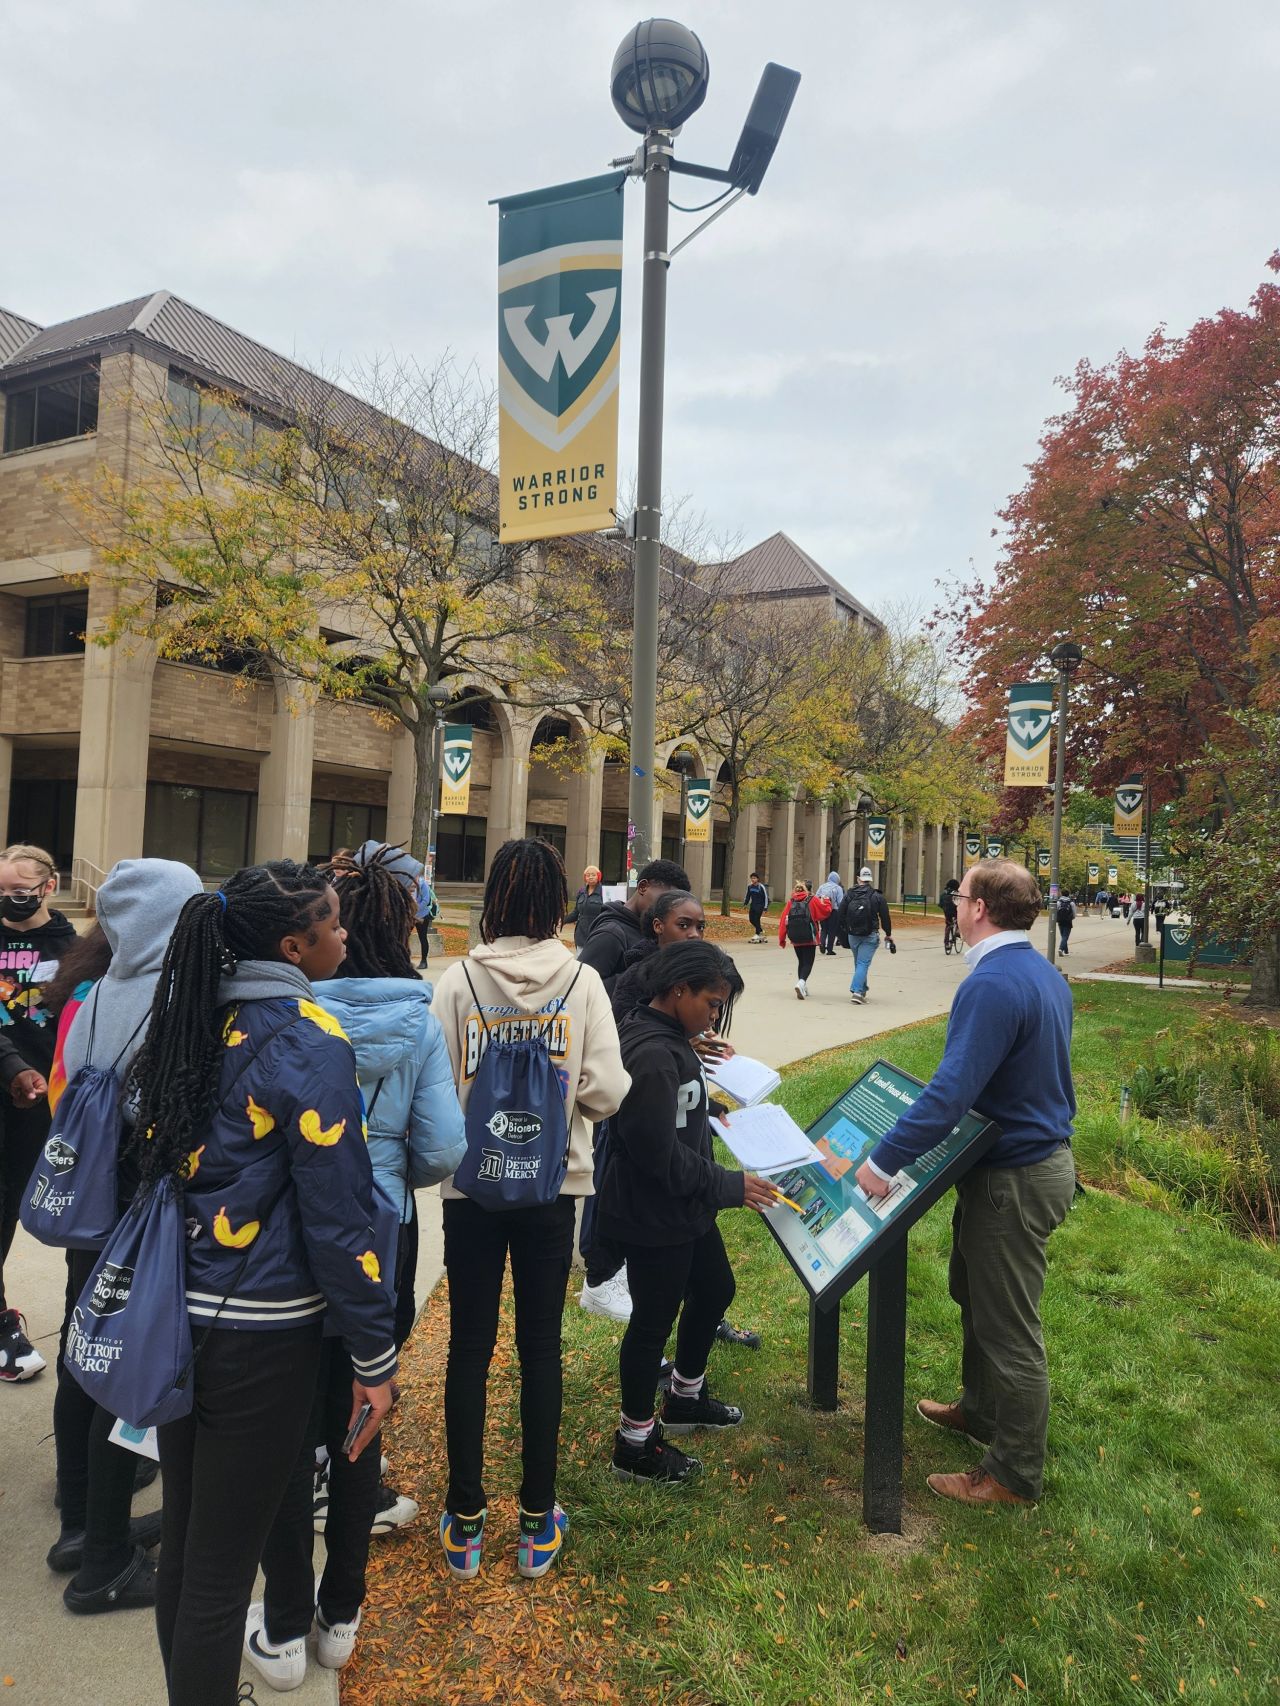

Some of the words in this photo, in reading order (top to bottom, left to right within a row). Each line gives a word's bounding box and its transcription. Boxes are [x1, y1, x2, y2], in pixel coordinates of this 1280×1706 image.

[513, 463, 605, 492] WARRIOR
[518, 484, 598, 511] STRONG
[74, 1335, 123, 1360] DETROIT
[74, 1348, 111, 1374] MERCY
[462, 1524, 477, 1532] NIKE
[525, 1520, 539, 1530] NIKE
[332, 1629, 351, 1640] NIKE
[284, 1643, 303, 1659] NIKE
